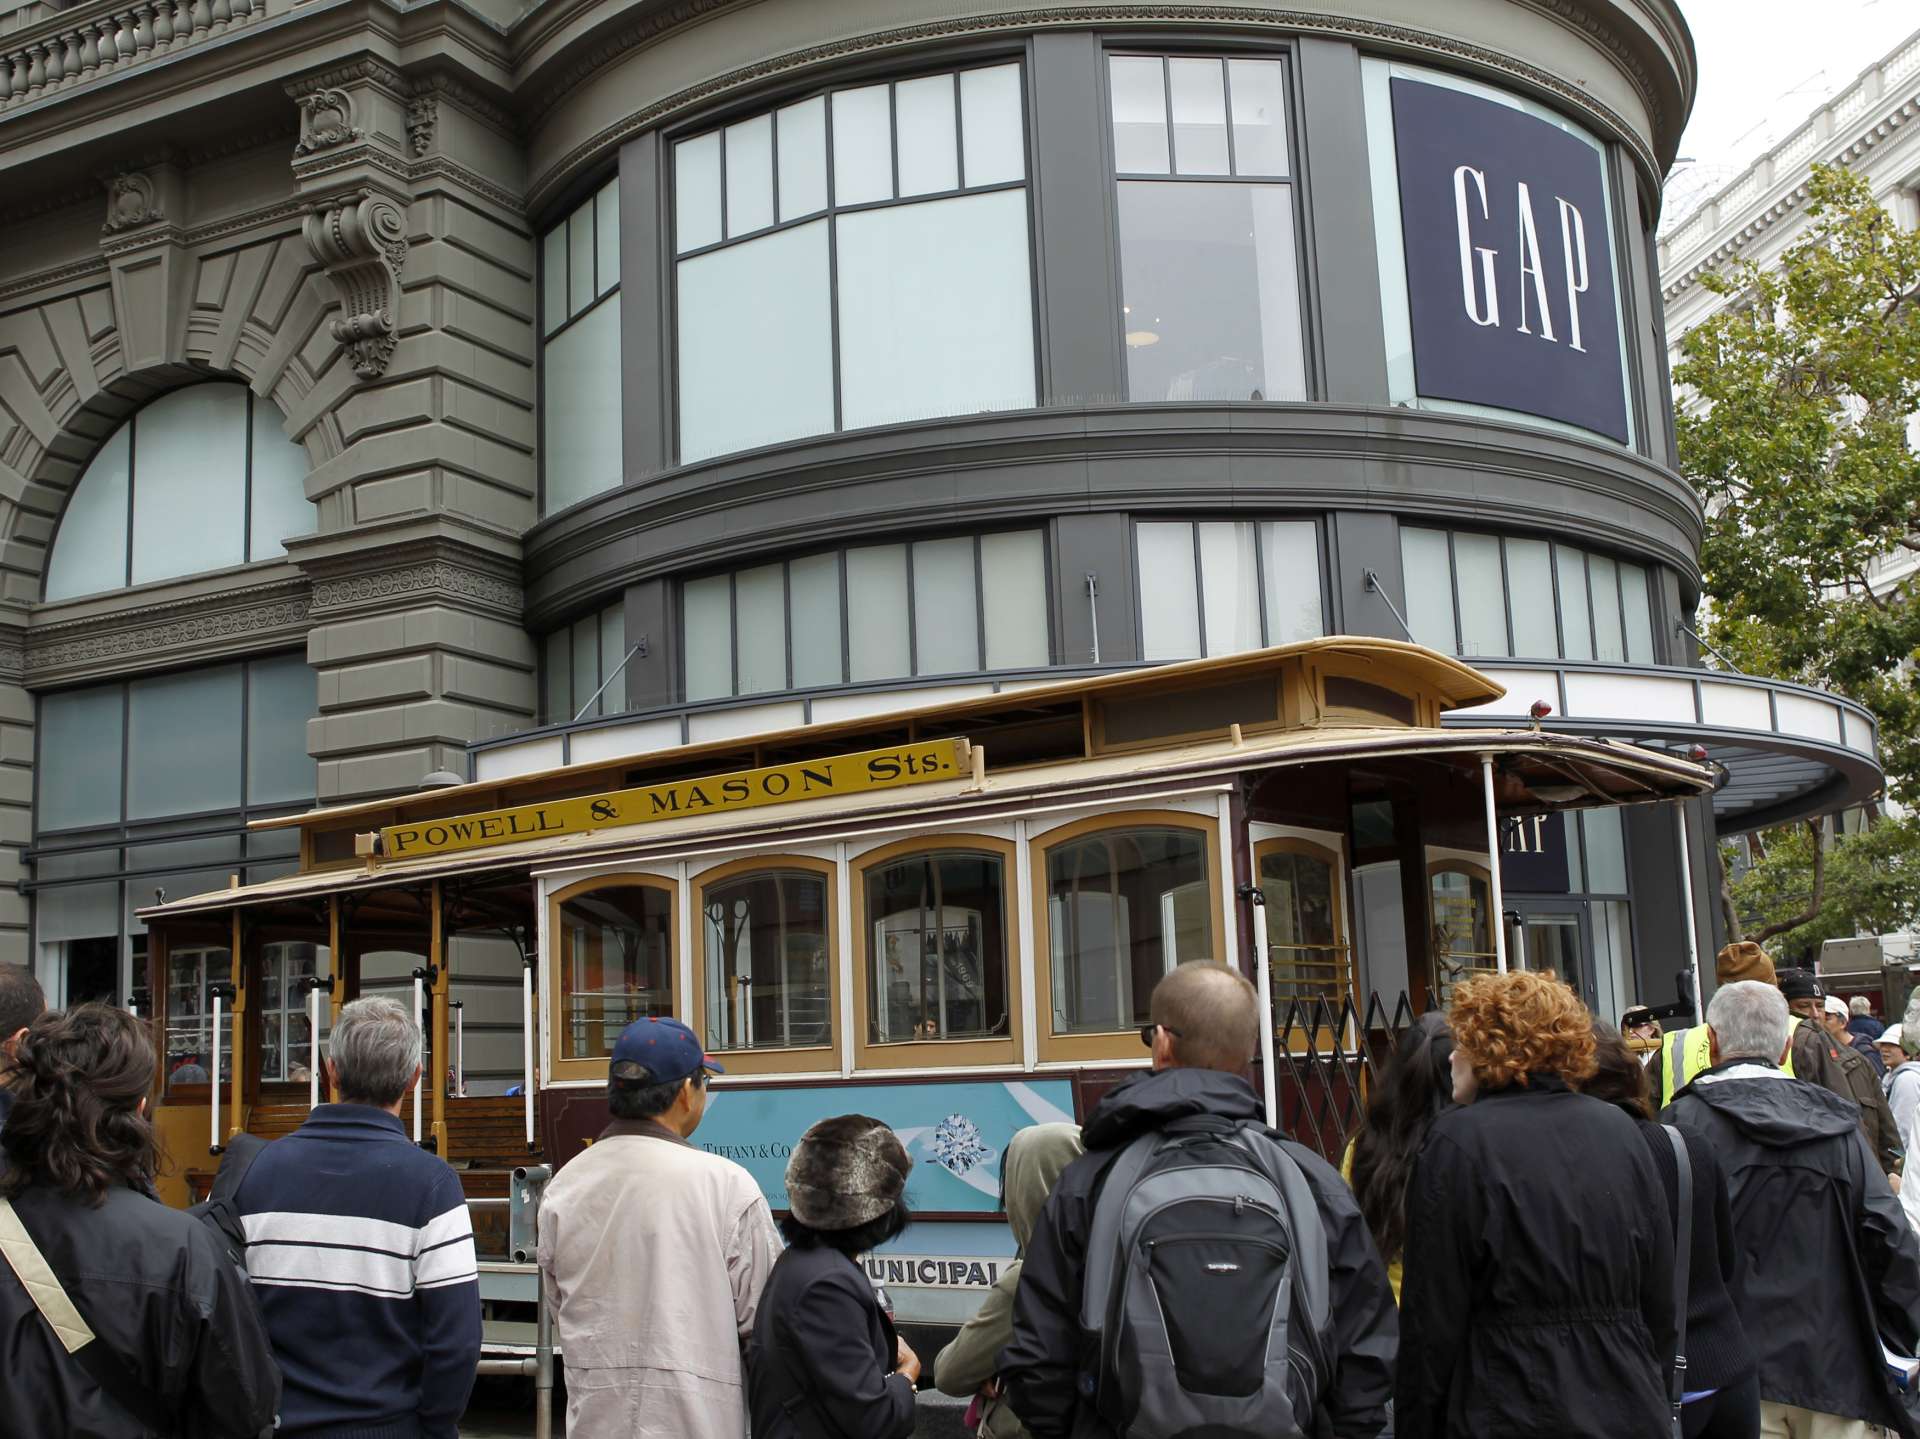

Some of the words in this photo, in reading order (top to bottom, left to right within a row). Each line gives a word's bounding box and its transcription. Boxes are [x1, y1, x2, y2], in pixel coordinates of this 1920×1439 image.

[1454, 165, 1589, 353] GAP
[394, 810, 564, 851] POWELL
[590, 799, 620, 821] &
[648, 765, 832, 815] MASON
[866, 752, 950, 783] Sts.
[861, 1258, 998, 1286] UNICIPAL
